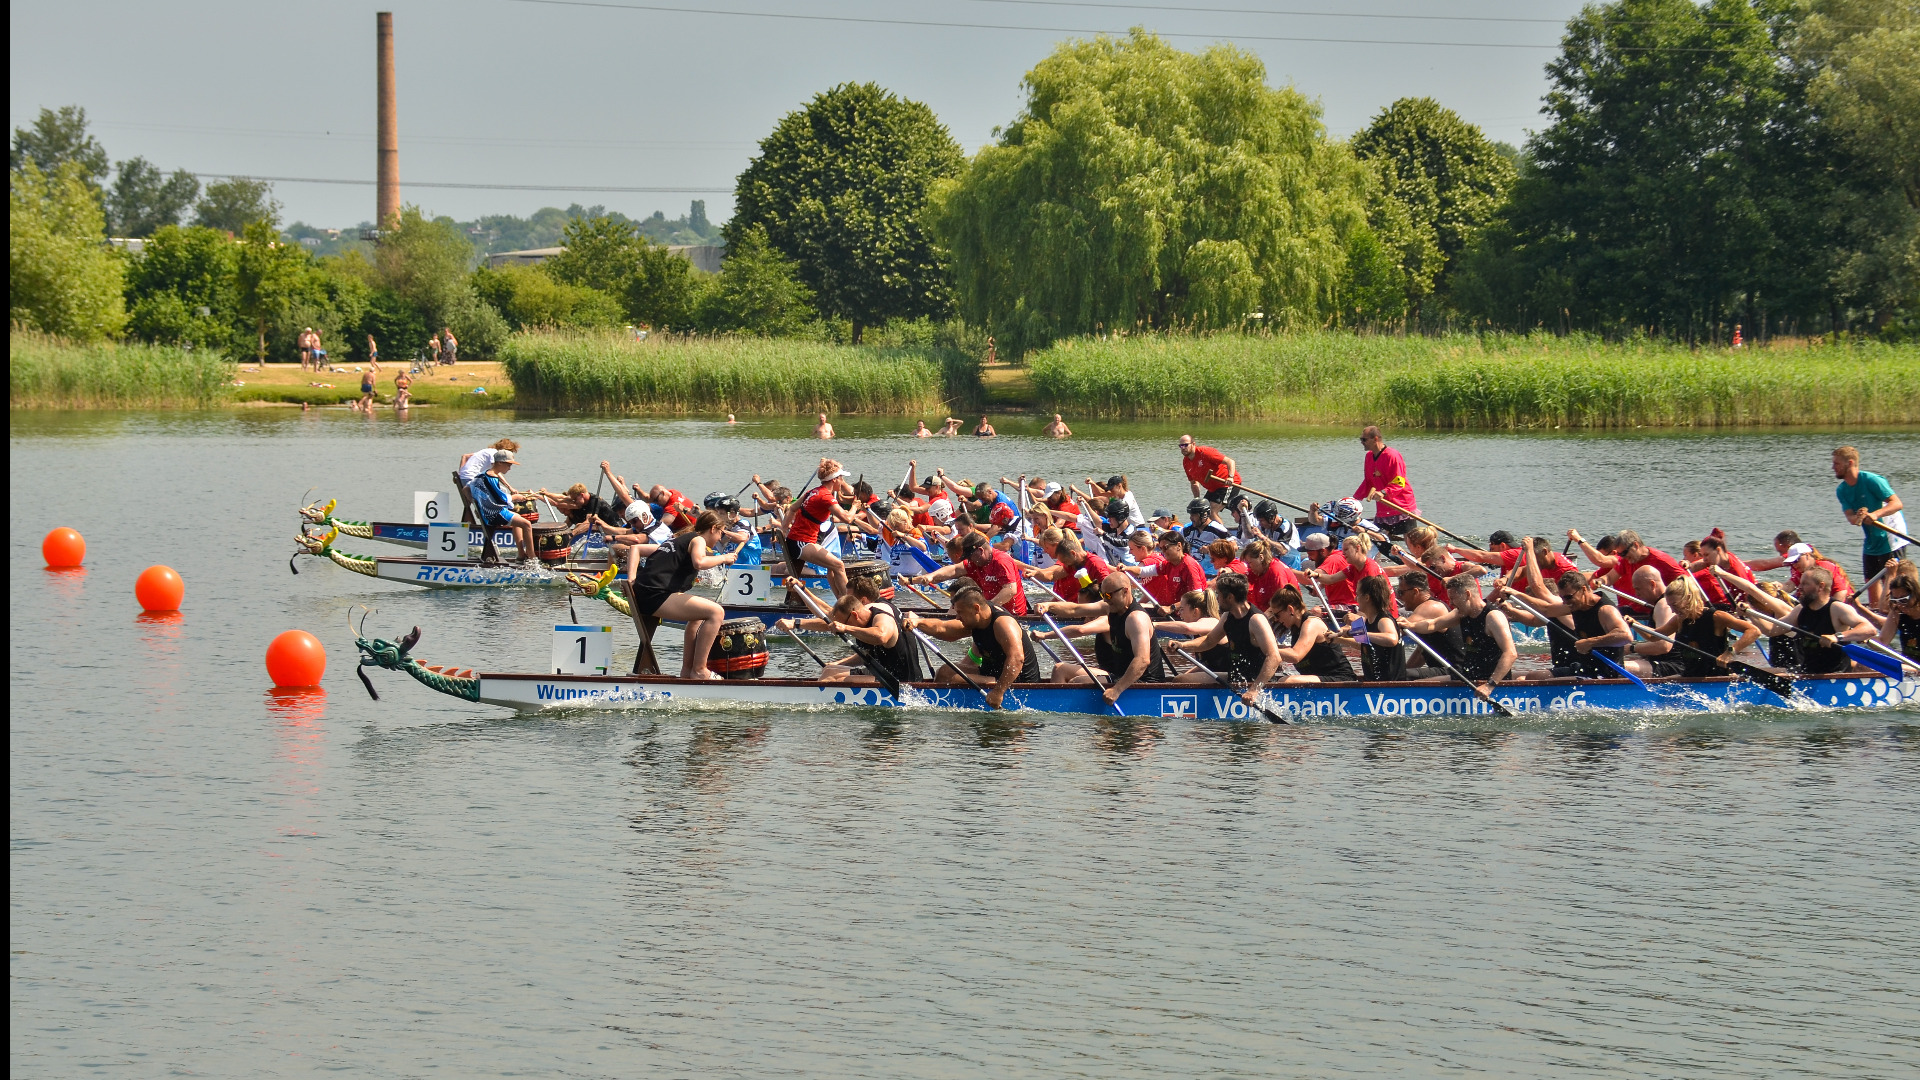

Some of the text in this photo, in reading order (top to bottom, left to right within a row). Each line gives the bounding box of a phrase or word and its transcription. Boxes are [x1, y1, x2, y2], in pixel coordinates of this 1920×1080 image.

[426, 501, 438, 520] 6
[396, 528, 415, 537] Fred
[441, 531, 456, 552] 5
[738, 572, 754, 596] 3
[575, 636, 587, 664] 1
[1212, 693, 1349, 719] Volsbank
